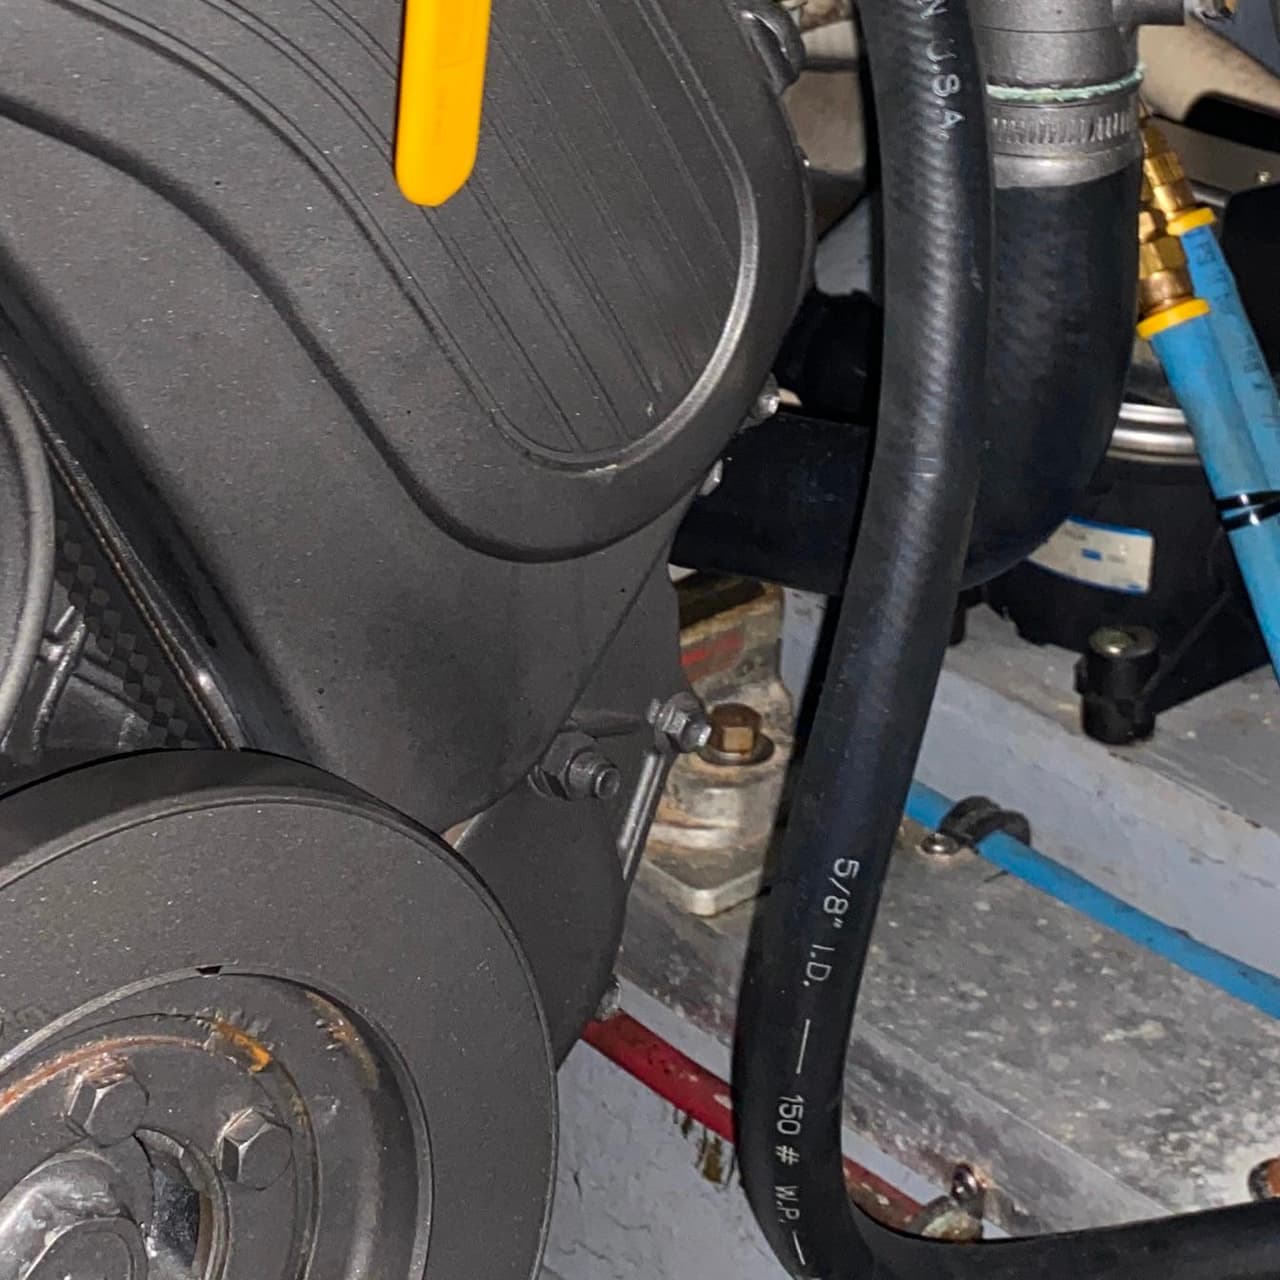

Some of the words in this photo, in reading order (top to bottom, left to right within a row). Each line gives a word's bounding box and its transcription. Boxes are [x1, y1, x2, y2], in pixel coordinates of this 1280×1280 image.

[823, 857, 860, 929] 5/8"
[802, 943, 836, 988] I.D.
[776, 1093, 805, 1136] 150
[775, 1145, 800, 1166] #
[774, 1185, 801, 1224] W.P.
